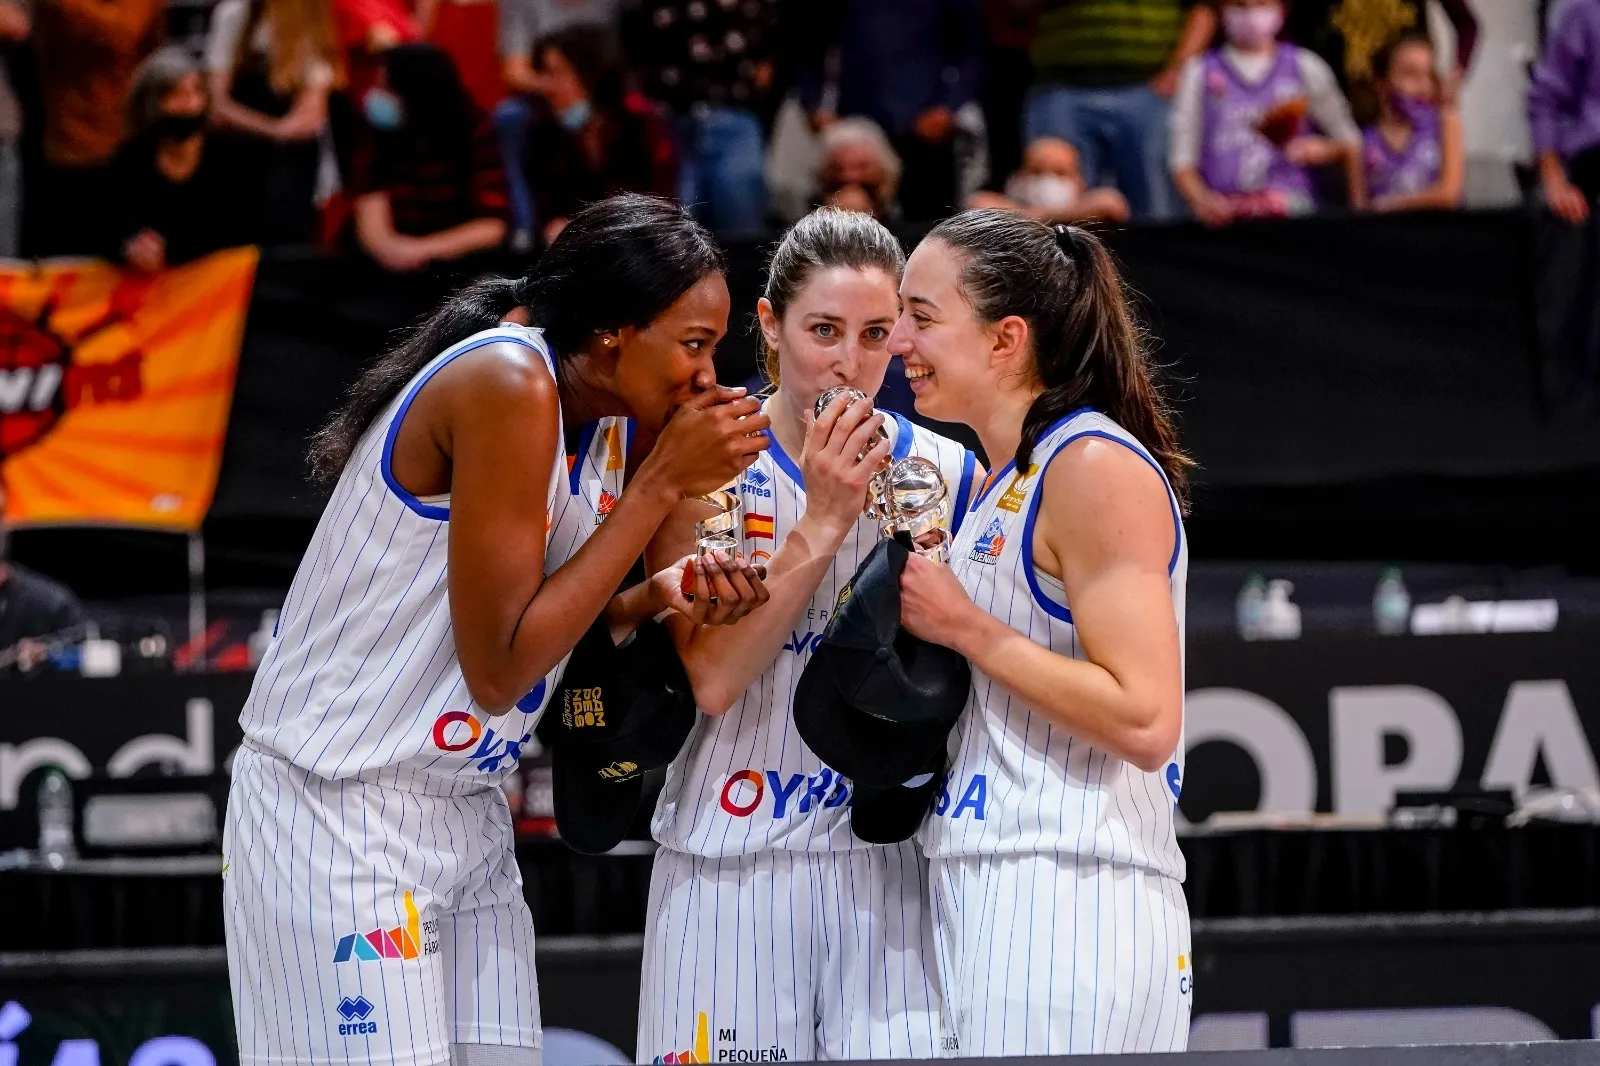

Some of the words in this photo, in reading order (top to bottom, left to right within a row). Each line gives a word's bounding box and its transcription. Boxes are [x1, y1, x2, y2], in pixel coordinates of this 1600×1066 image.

[741, 483, 771, 498] errea
[572, 689, 584, 727] NAS
[592, 686, 606, 727] CAM
[338, 1021, 377, 1036] errea
[719, 1030, 736, 1042] MI
[719, 1045, 788, 1063] PEQUEÑA
